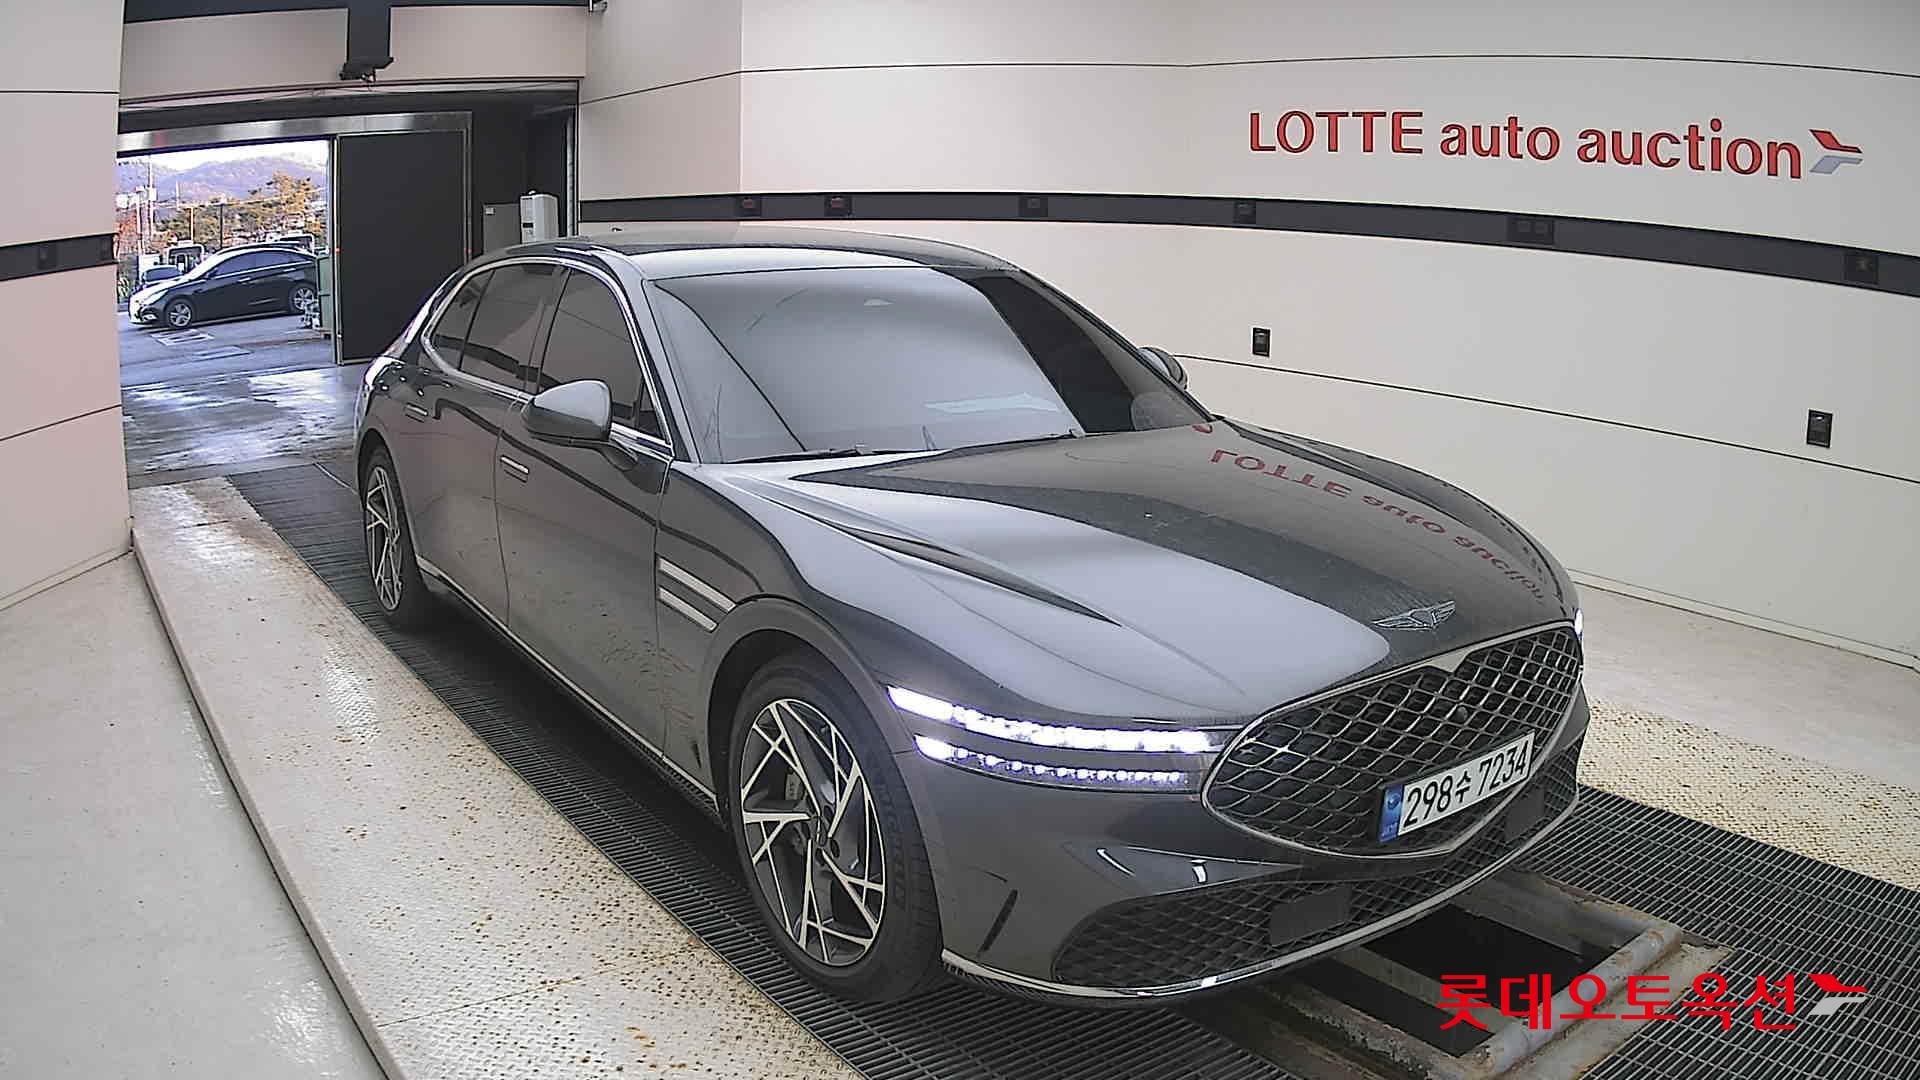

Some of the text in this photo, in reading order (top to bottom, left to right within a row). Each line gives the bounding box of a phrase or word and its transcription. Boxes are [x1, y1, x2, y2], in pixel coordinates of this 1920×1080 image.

[1249, 111, 1803, 180] LOTTE auto auction
[1403, 739, 1530, 828] 298수 7234
